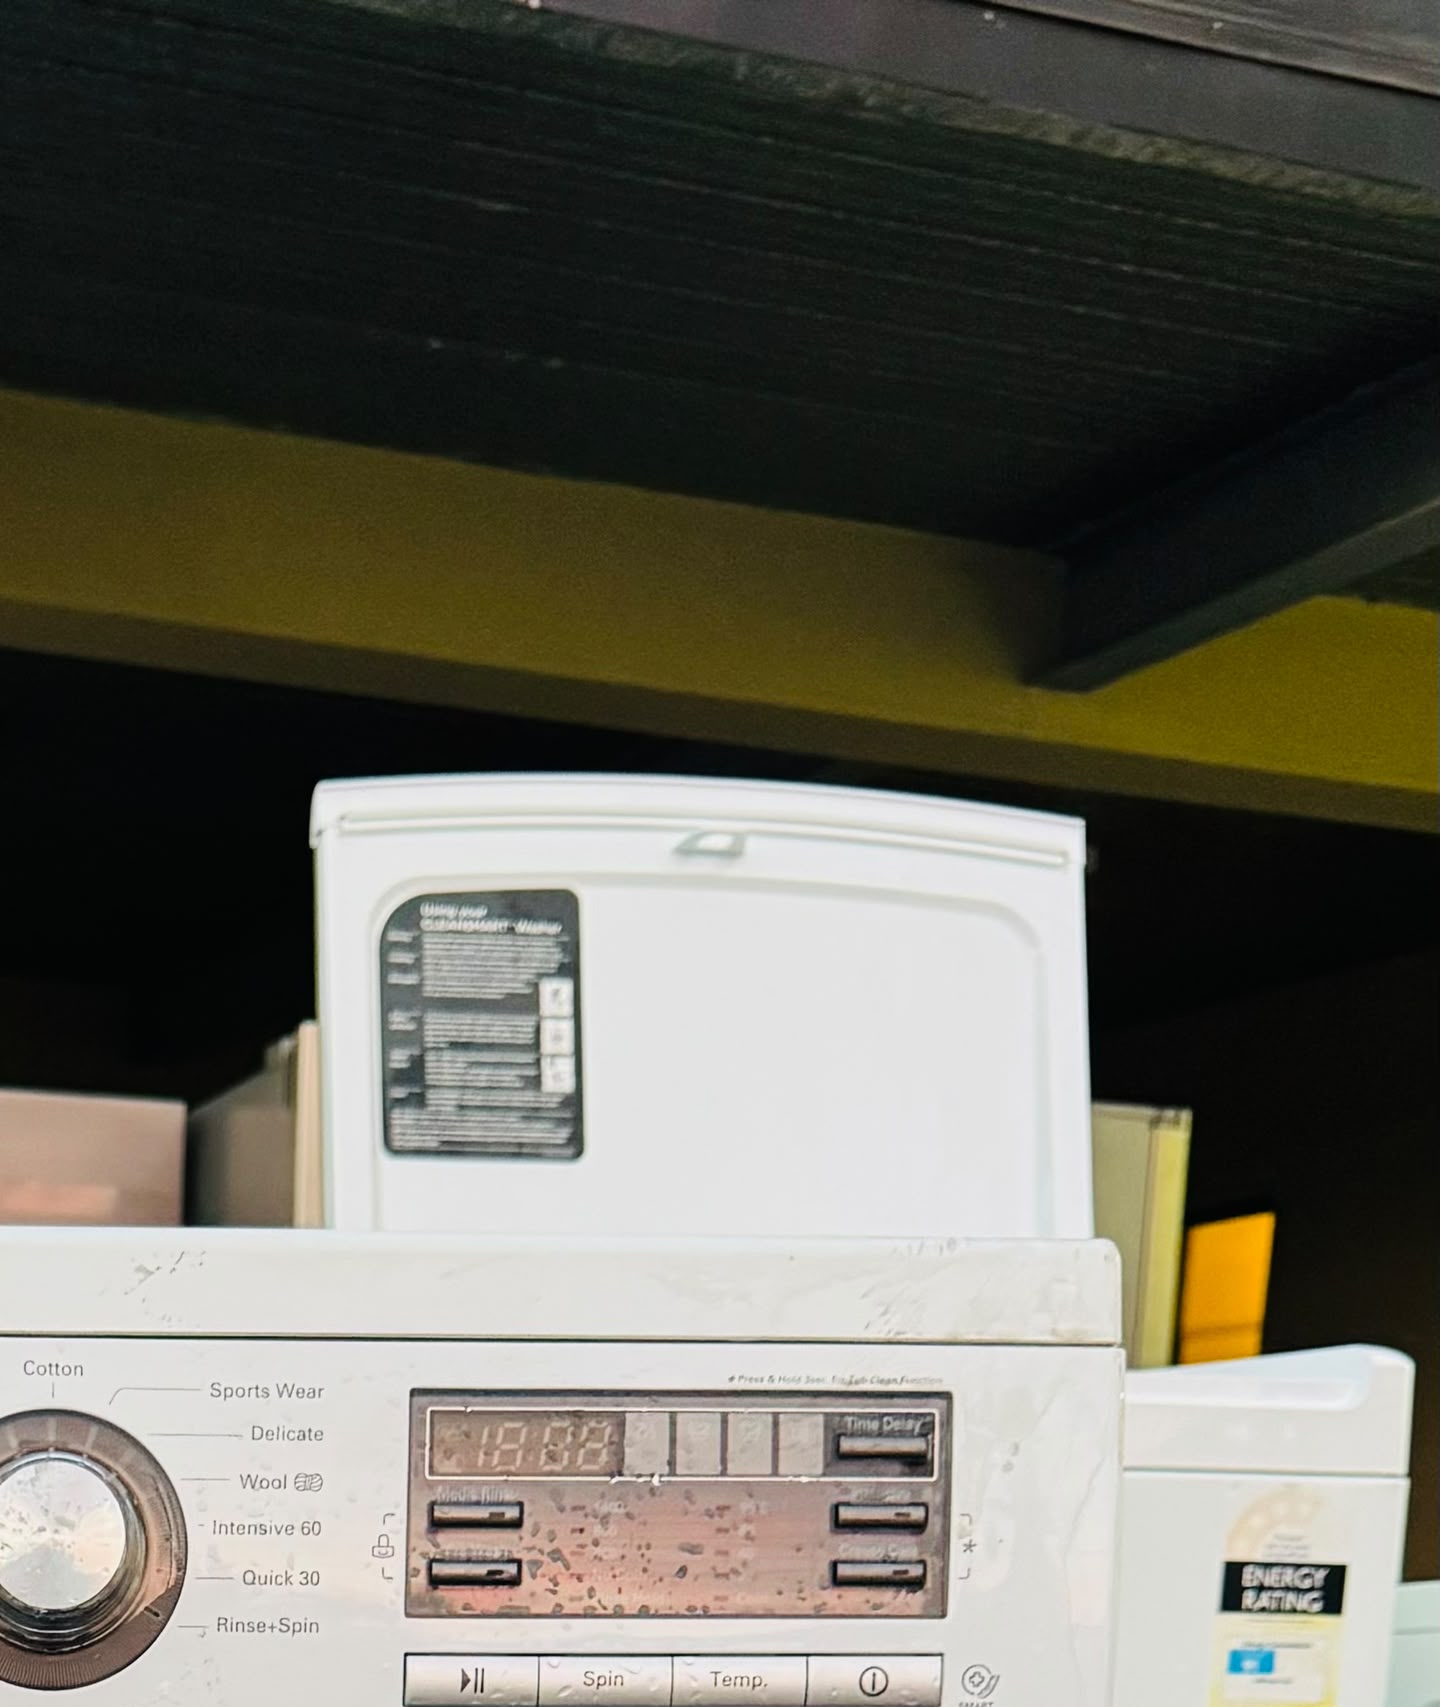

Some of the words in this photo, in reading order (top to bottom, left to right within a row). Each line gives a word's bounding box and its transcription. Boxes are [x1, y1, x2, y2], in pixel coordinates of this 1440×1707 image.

[23, 1361, 84, 1377] Cotton
[210, 1382, 271, 1401] Sports
[274, 1382, 325, 1399] Wear
[251, 1425, 324, 1441] Delicate
[846, 1416, 879, 1431] Time
[883, 1416, 924, 1433] Delay
[239, 1474, 288, 1490] Wool
[212, 1520, 295, 1536] Intensive
[300, 1520, 322, 1536] 60
[242, 1571, 294, 1587] Quick
[299, 1571, 320, 1586] 30
[1241, 1564, 1330, 1589] ENERGY
[1241, 1589, 1324, 1613] RATING
[216, 1617, 320, 1636] Rinse+Spin
[583, 1671, 624, 1689] Spin
[710, 1671, 768, 1689] Temp.
